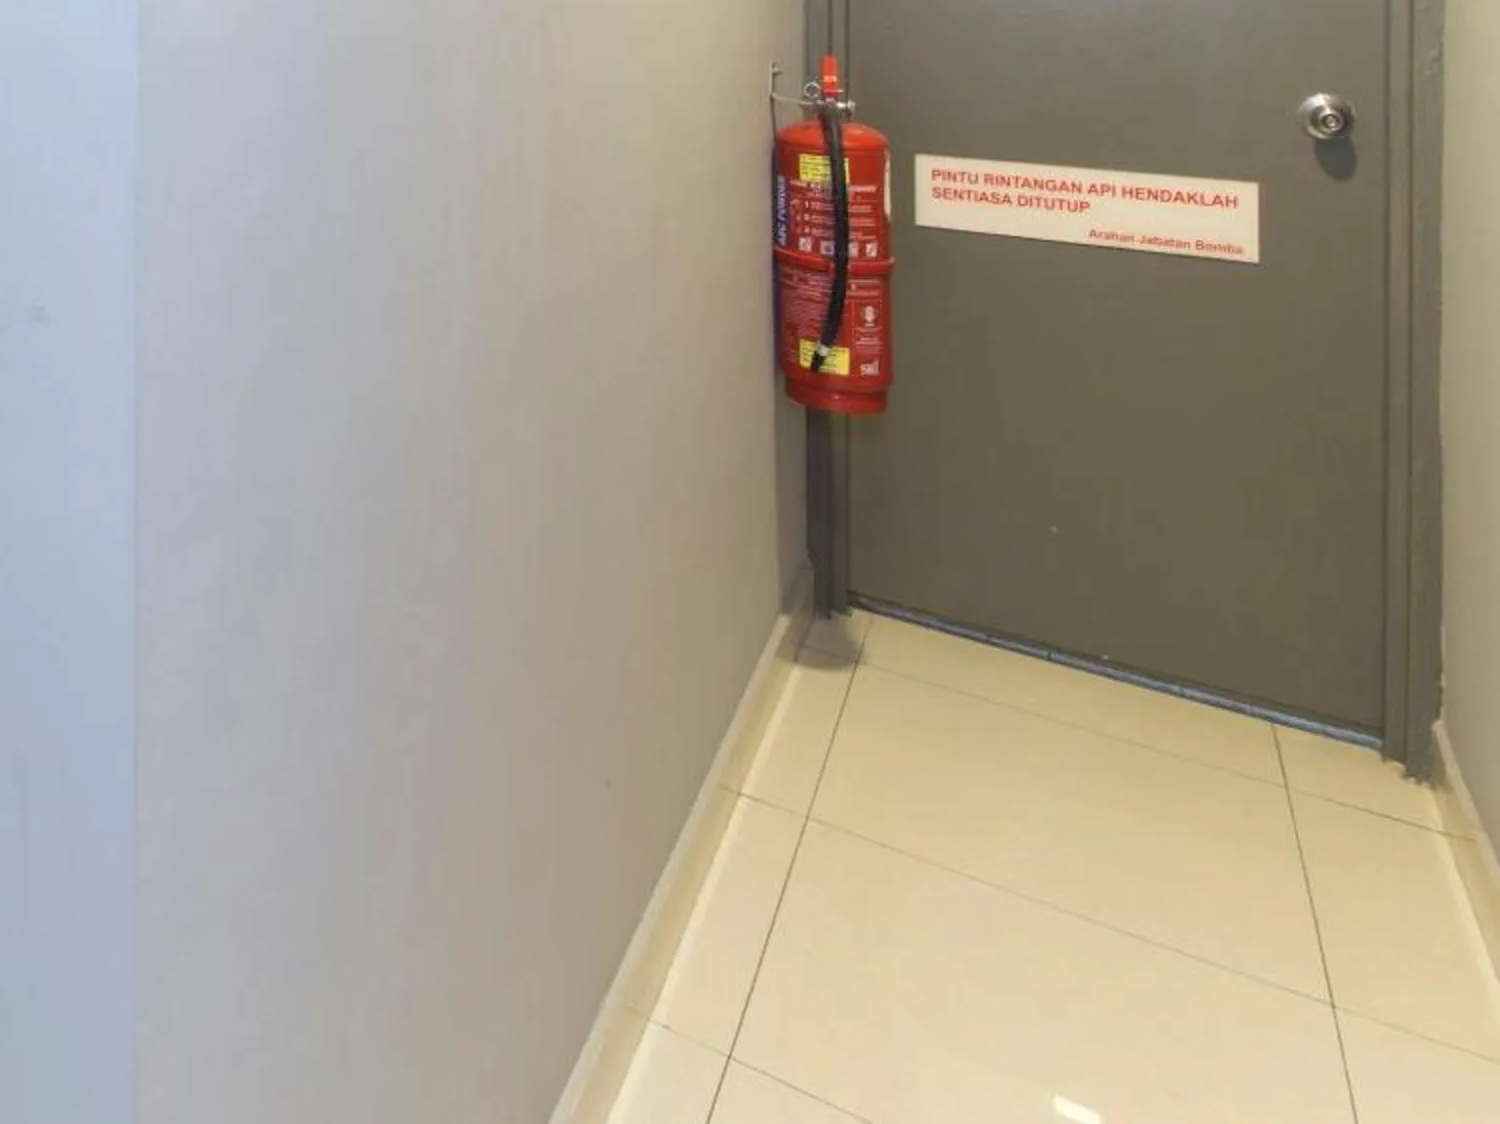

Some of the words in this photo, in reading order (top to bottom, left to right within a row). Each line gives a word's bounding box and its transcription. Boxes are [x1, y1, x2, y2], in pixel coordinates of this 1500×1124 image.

[931, 169, 979, 185] PINTU
[983, 173, 1083, 194] RINTANGAN
[1087, 183, 1117, 198] API
[1121, 187, 1238, 209] HENDAKLAH
[931, 186, 1013, 206] SENTIASA
[1016, 195, 1091, 213] DITUTUP
[1088, 228, 1135, 243] Arahan
[1140, 235, 1191, 249] Jabatan
[1195, 239, 1245, 255] Bomba
